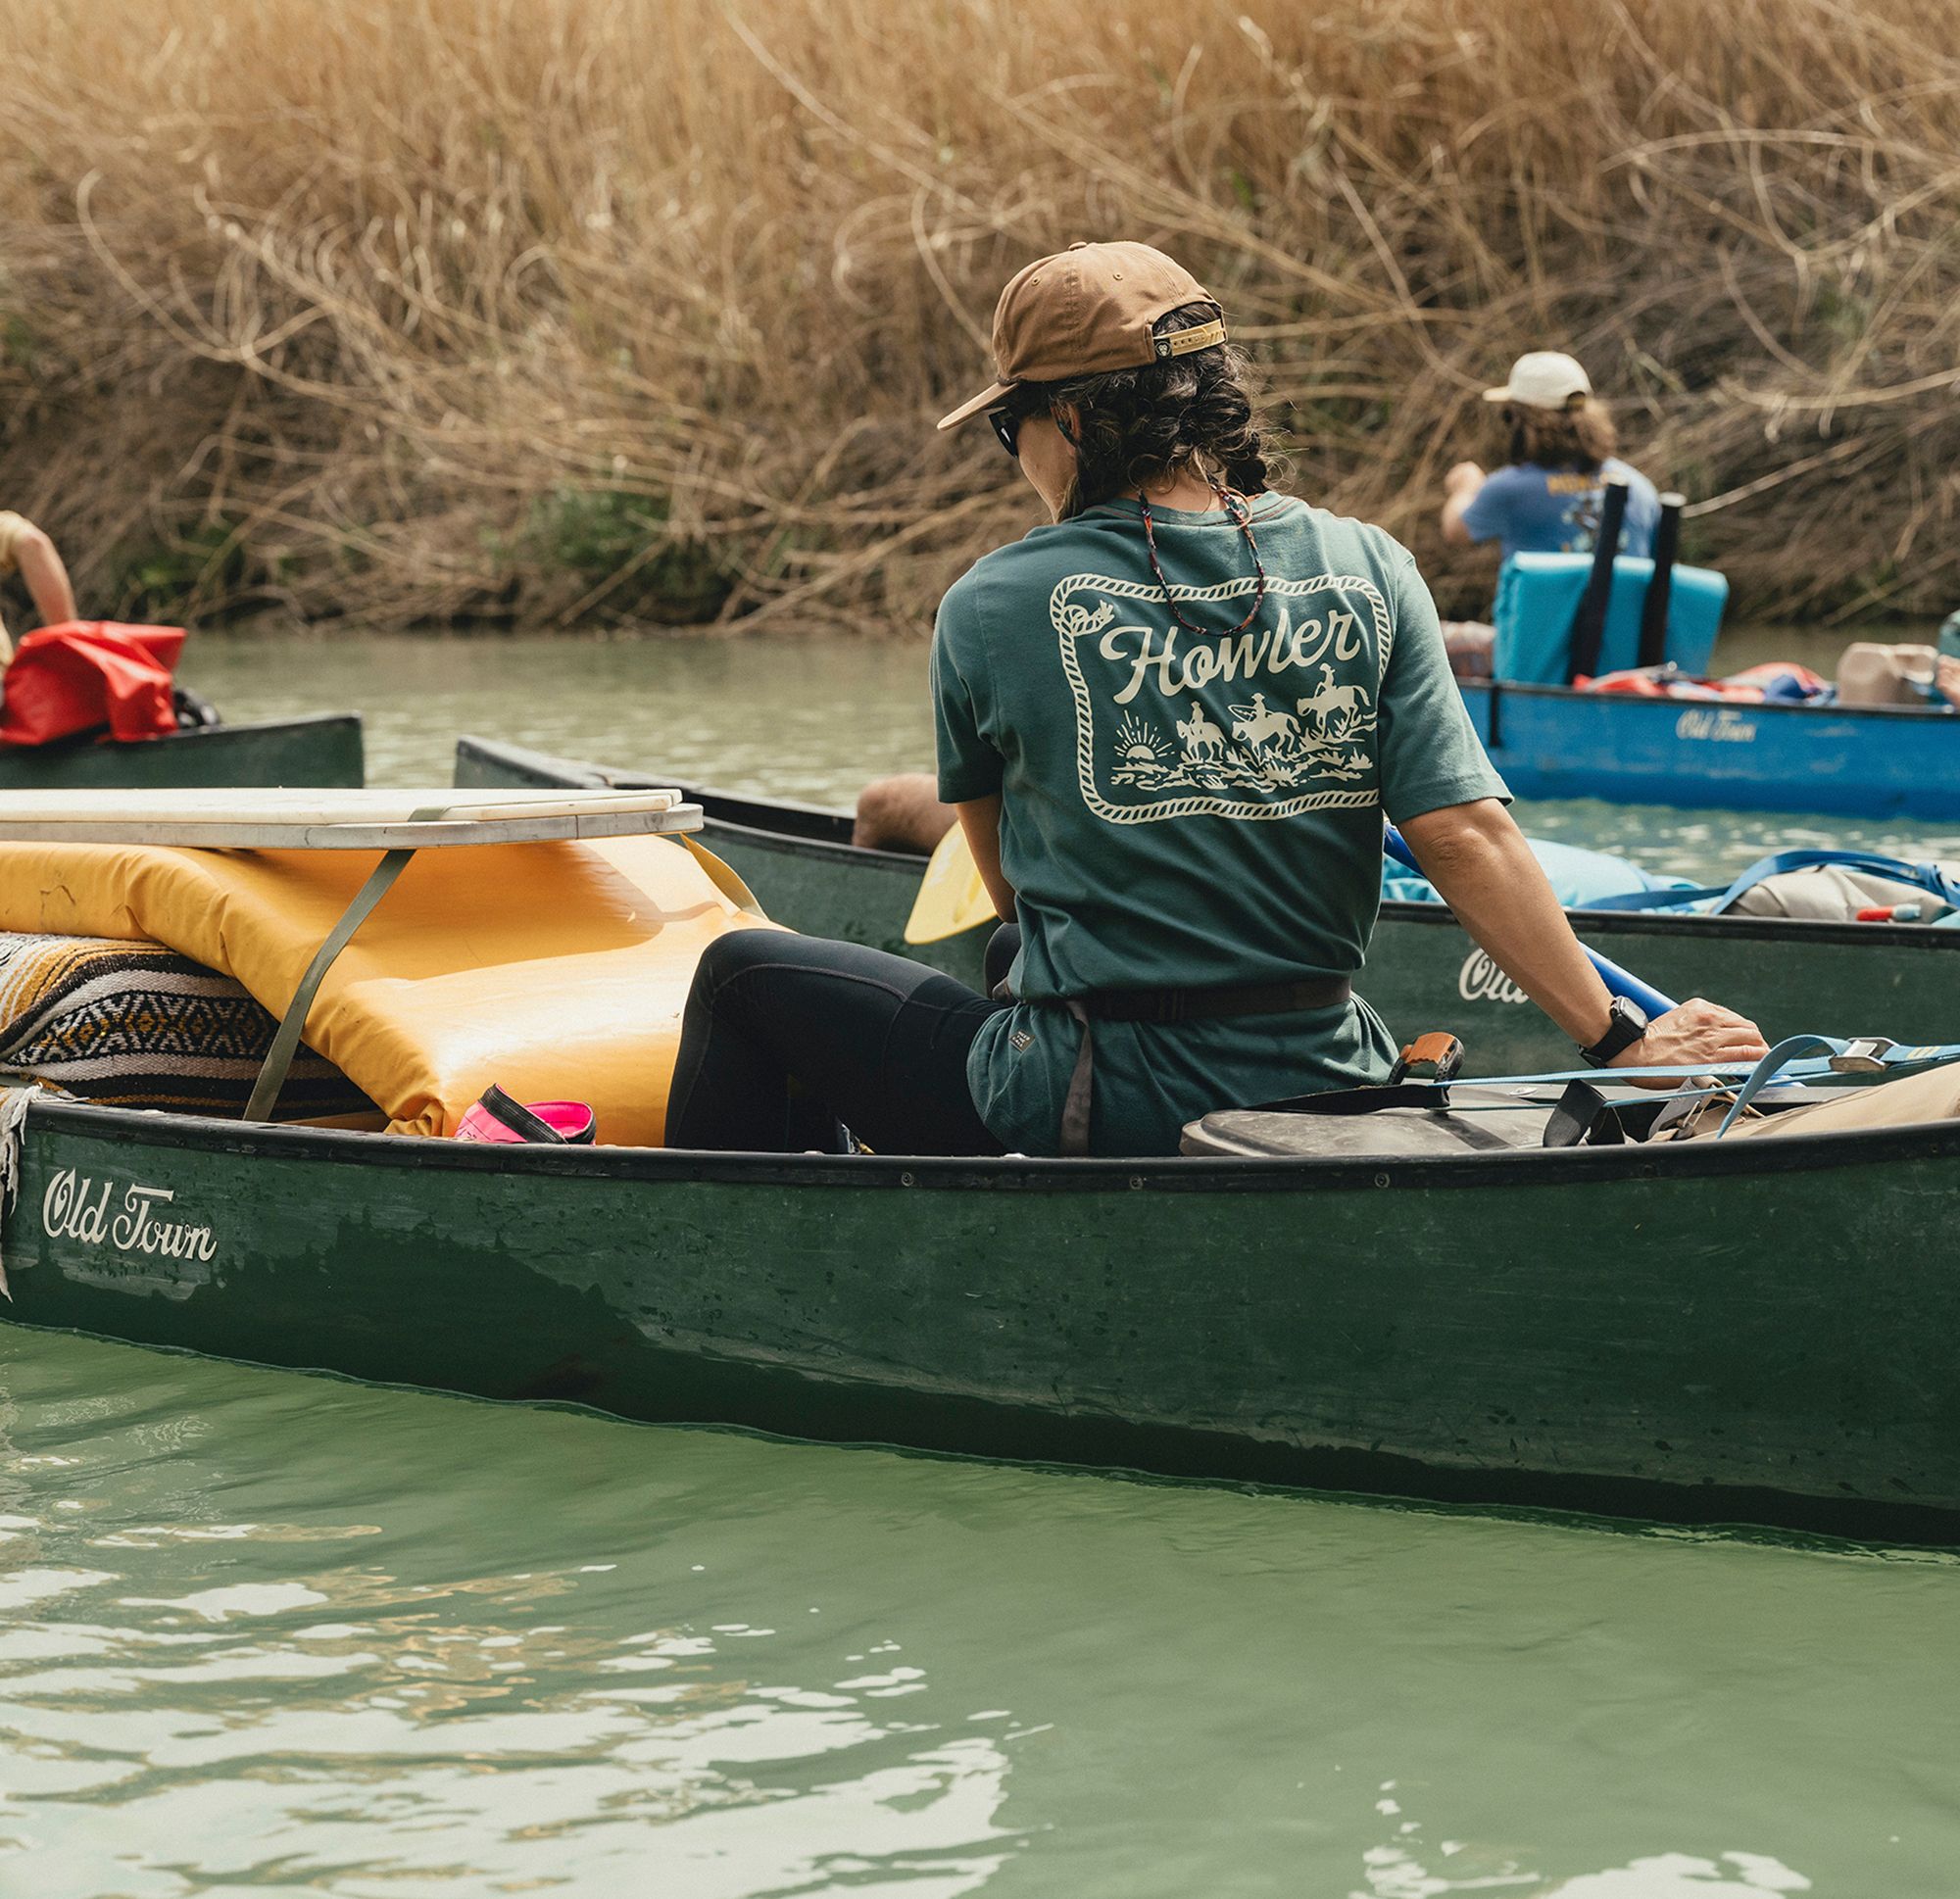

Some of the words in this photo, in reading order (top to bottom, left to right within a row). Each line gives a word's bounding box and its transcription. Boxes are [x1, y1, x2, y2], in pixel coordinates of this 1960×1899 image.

[1099, 608, 1361, 705] Howler
[43, 1167, 114, 1243] Old
[112, 1183, 218, 1261] Town
